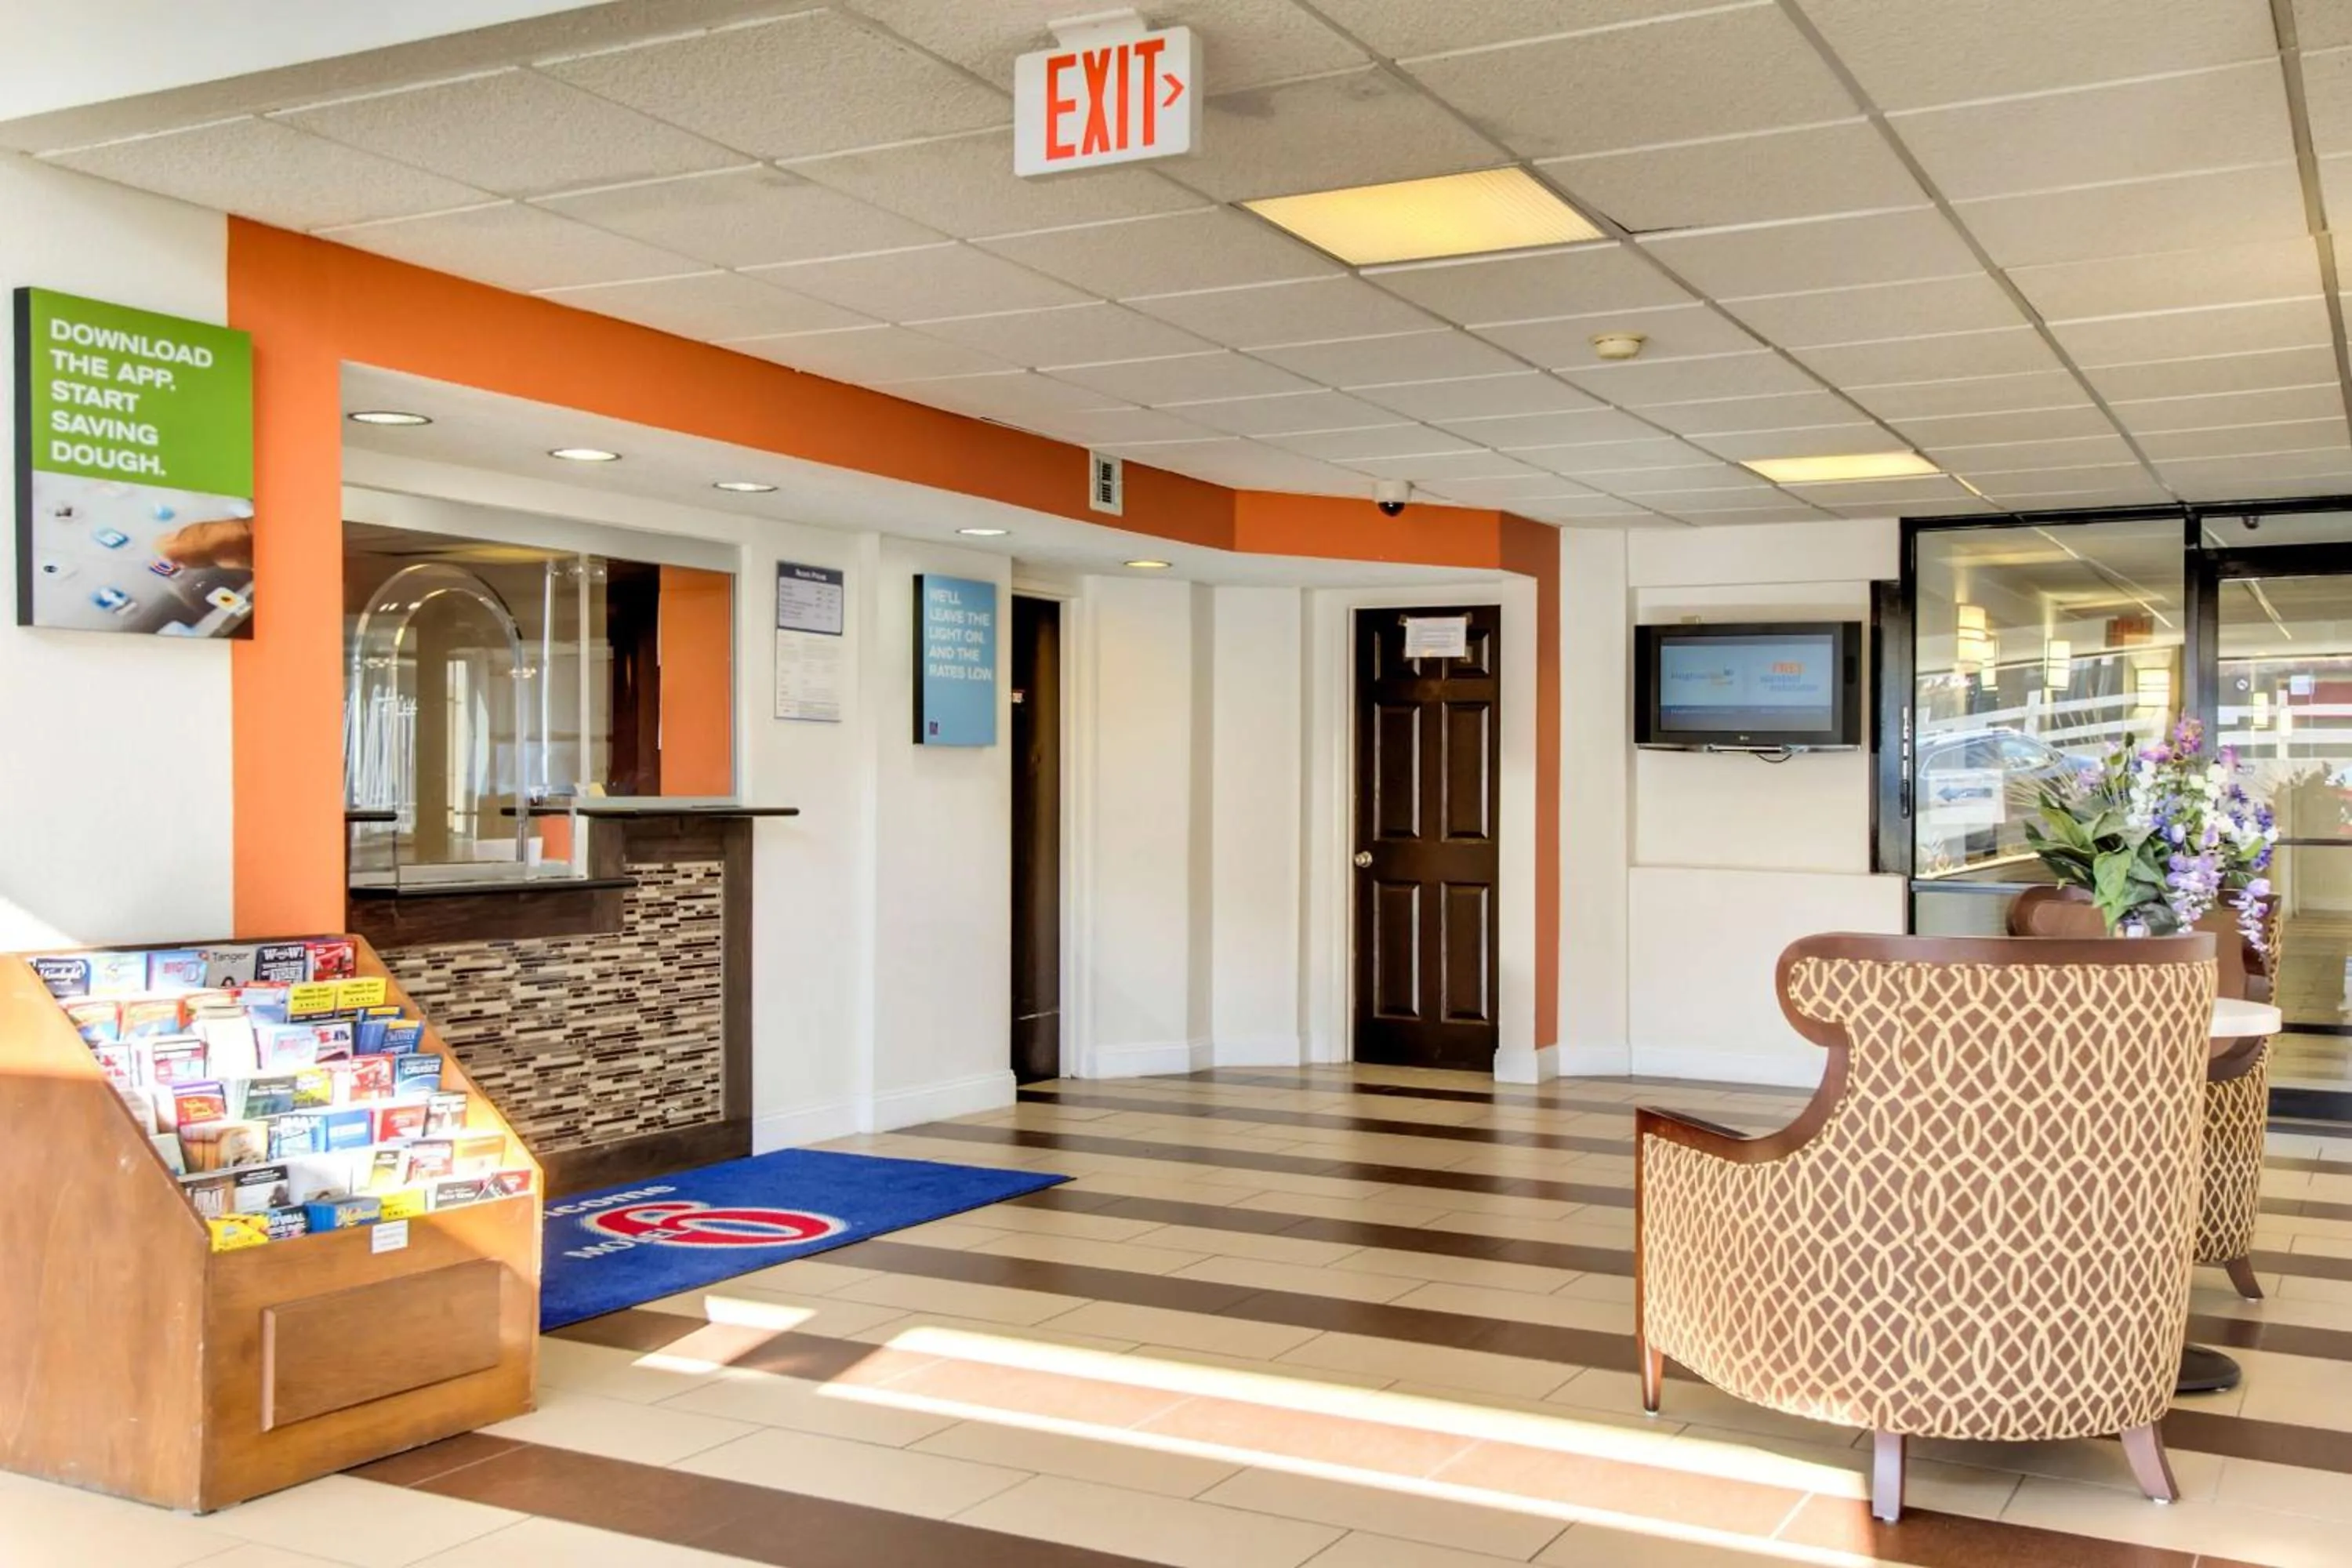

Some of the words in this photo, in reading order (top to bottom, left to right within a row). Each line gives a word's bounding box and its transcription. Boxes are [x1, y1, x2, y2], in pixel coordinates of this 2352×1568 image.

[1046, 38, 1165, 161] EXIT
[50, 318, 213, 368] DOWNLOAD
[49, 349, 109, 380] THE
[117, 362, 176, 391] APP.
[51, 379, 140, 413] START
[51, 410, 159, 446] SAVING
[51, 441, 167, 477] DOUGH.
[929, 589, 961, 604] WE'LL
[929, 607, 964, 623] LEAVE
[967, 612, 991, 626] THE
[929, 626, 963, 641] LIGHT
[929, 645, 955, 660] AND
[957, 648, 980, 662] THE
[929, 664, 965, 680] RATES
[212, 951, 250, 965] Tanger
[544, 1185, 677, 1219] lcome
[563, 1228, 693, 1259] MOTEL
